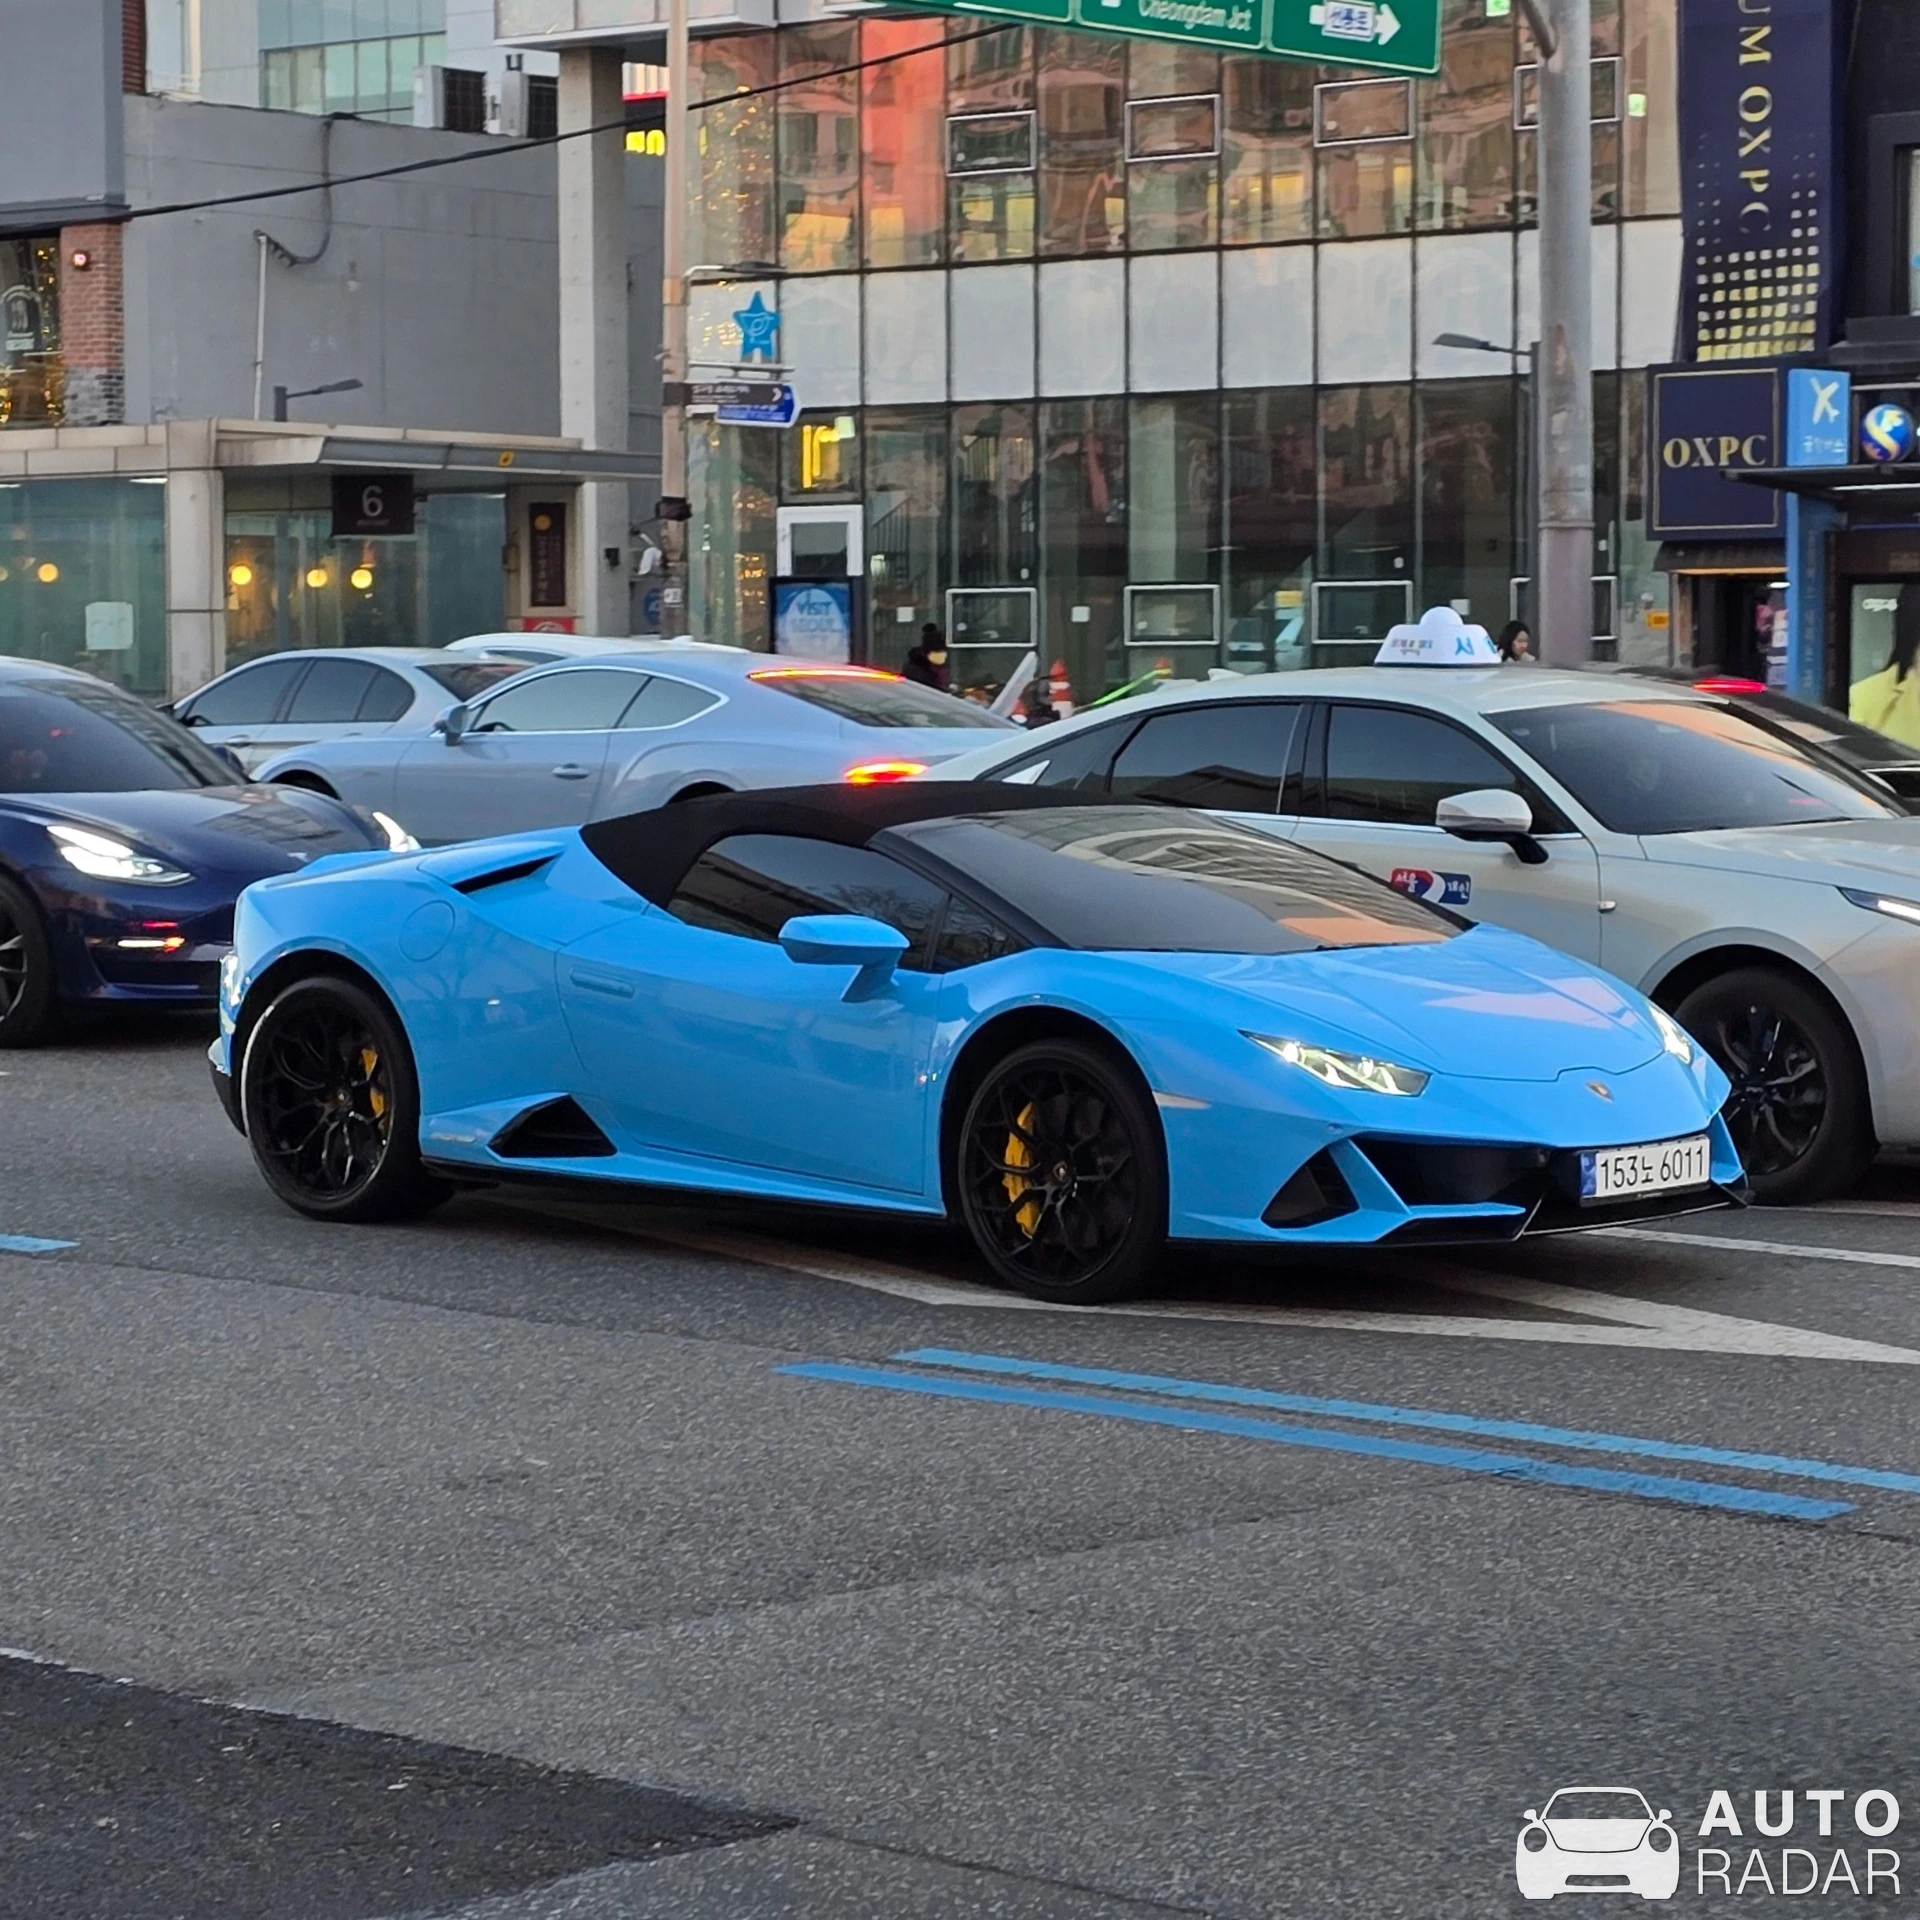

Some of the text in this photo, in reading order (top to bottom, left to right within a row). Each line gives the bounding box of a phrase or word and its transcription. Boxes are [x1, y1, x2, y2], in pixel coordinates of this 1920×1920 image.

[1138, 0, 1252, 31] Cheongdam Jct
[1738, 86, 1772, 233] OXPC
[1663, 434, 1767, 469] OXPC
[362, 485, 383, 517] 6
[1395, 871, 1419, 893] 서울
[1600, 1145, 1704, 1190] 153노 6011
